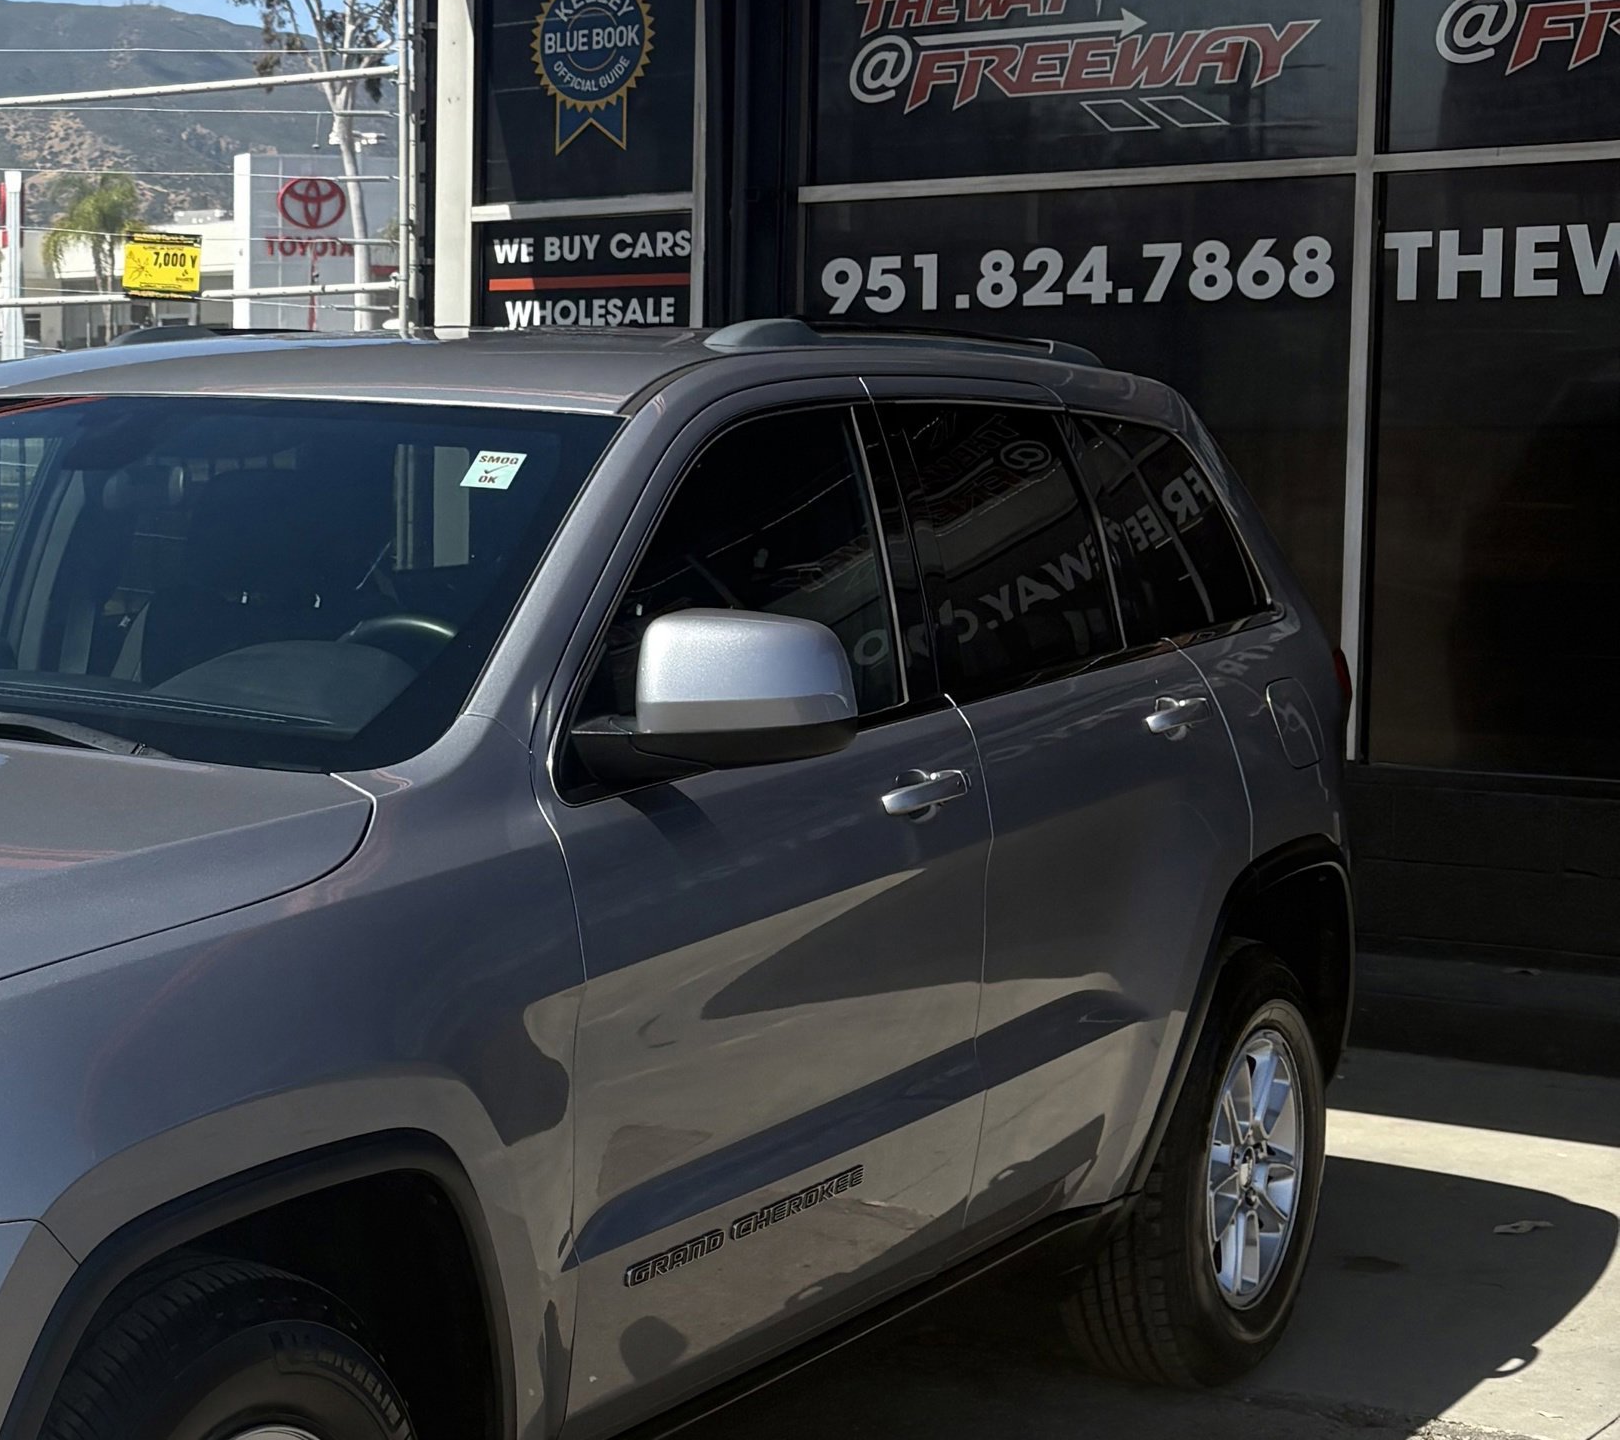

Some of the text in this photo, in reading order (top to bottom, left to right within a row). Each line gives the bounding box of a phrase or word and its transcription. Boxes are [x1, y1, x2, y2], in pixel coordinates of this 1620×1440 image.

[544, 24, 640, 54] BLUE BOOK
[553, 55, 630, 92] OFFICIAL GUIDE
[848, 18, 1322, 115] @FREEWAY
[153, 252, 186, 268] 7,000
[265, 236, 355, 256] TOYOTA
[493, 230, 692, 264] WE BUY CARS
[820, 235, 1335, 315] 951.824.7868
[505, 297, 675, 329] WHOLESALE
[478, 455, 519, 465] SMOG
[478, 475, 498, 484] OK
[624, 1164, 865, 1288] GRAND CHEROKEE
